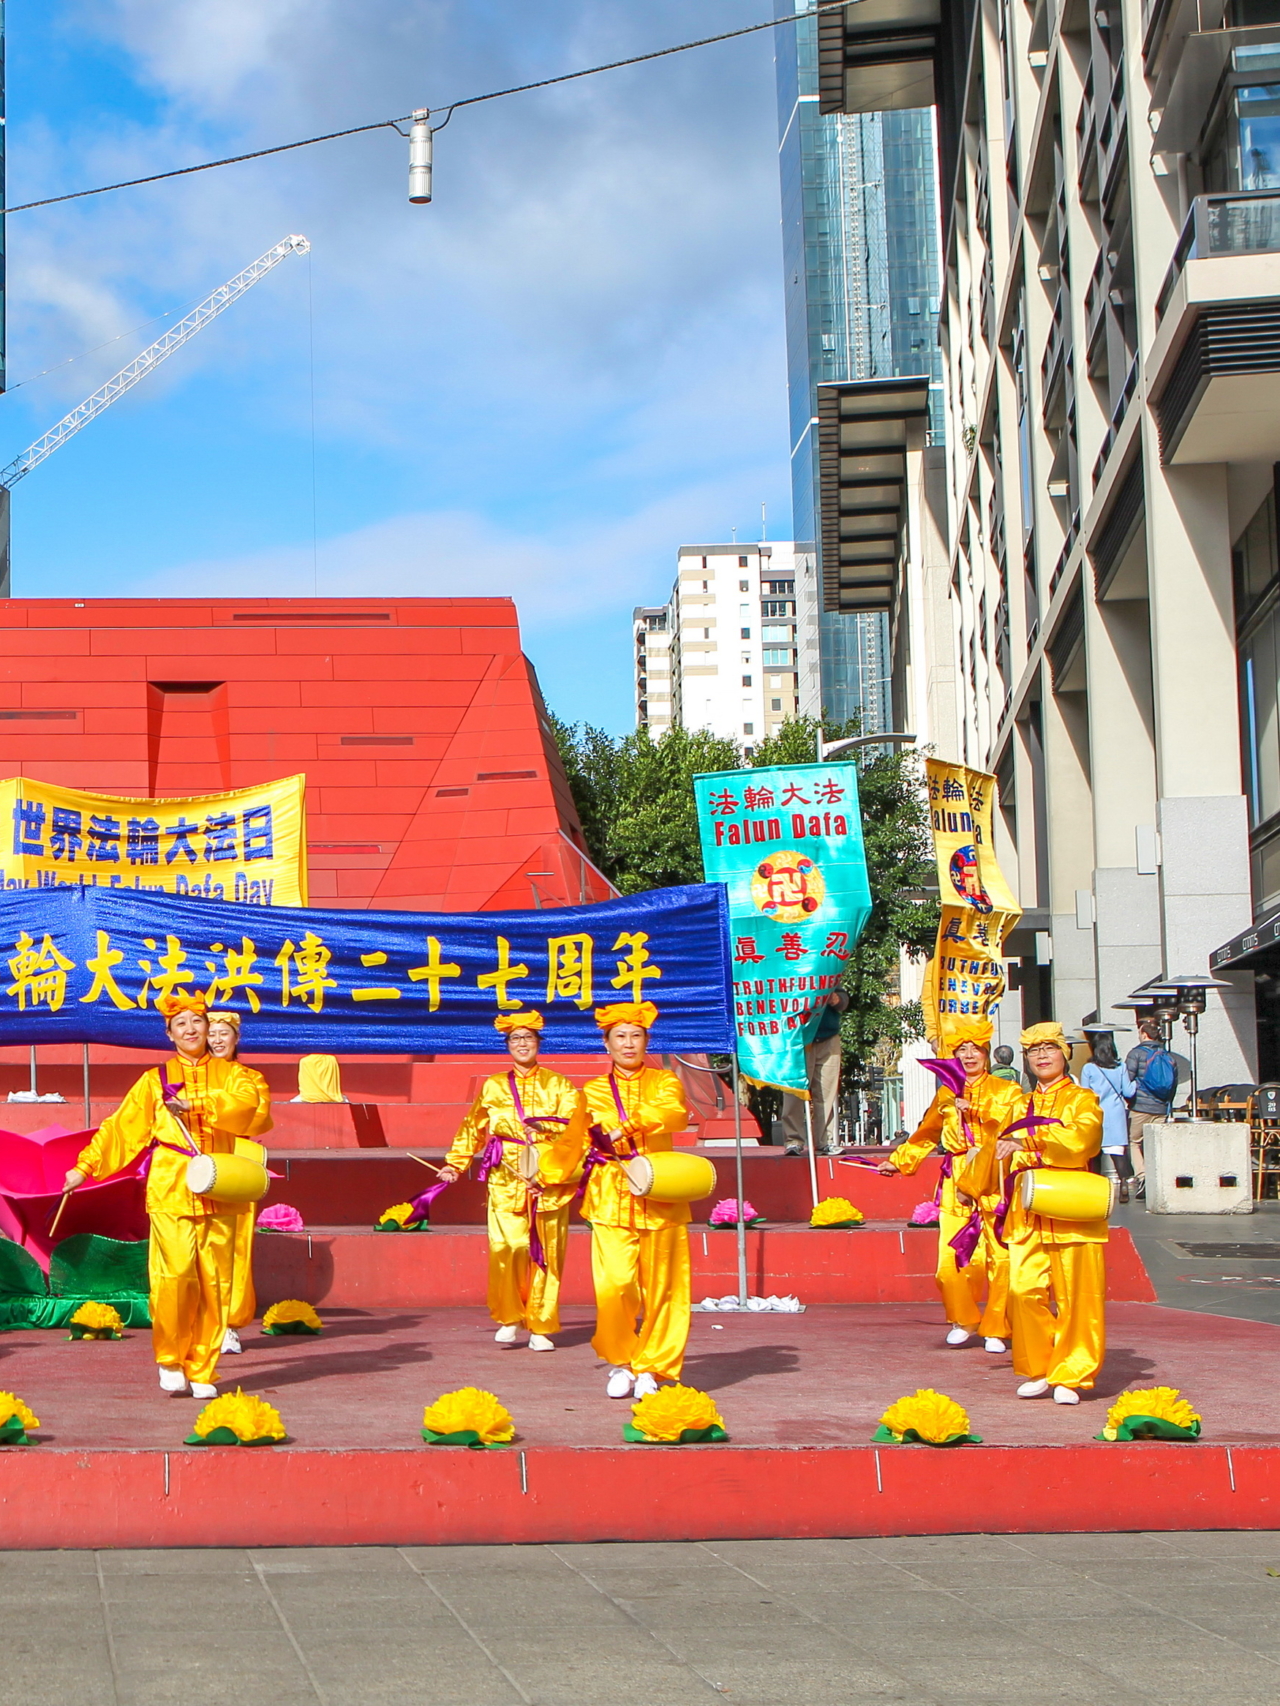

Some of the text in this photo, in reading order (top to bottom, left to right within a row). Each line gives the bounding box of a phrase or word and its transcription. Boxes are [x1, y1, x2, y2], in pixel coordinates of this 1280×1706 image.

[708, 778, 845, 816] 法輪大法
[12, 798, 274, 865] 世界法輪大法日
[715, 812, 847, 846] Falun Dafa
[931, 806, 973, 833] alun
[235, 871, 274, 906] Day
[733, 973, 843, 996] TRUTHFULNES
